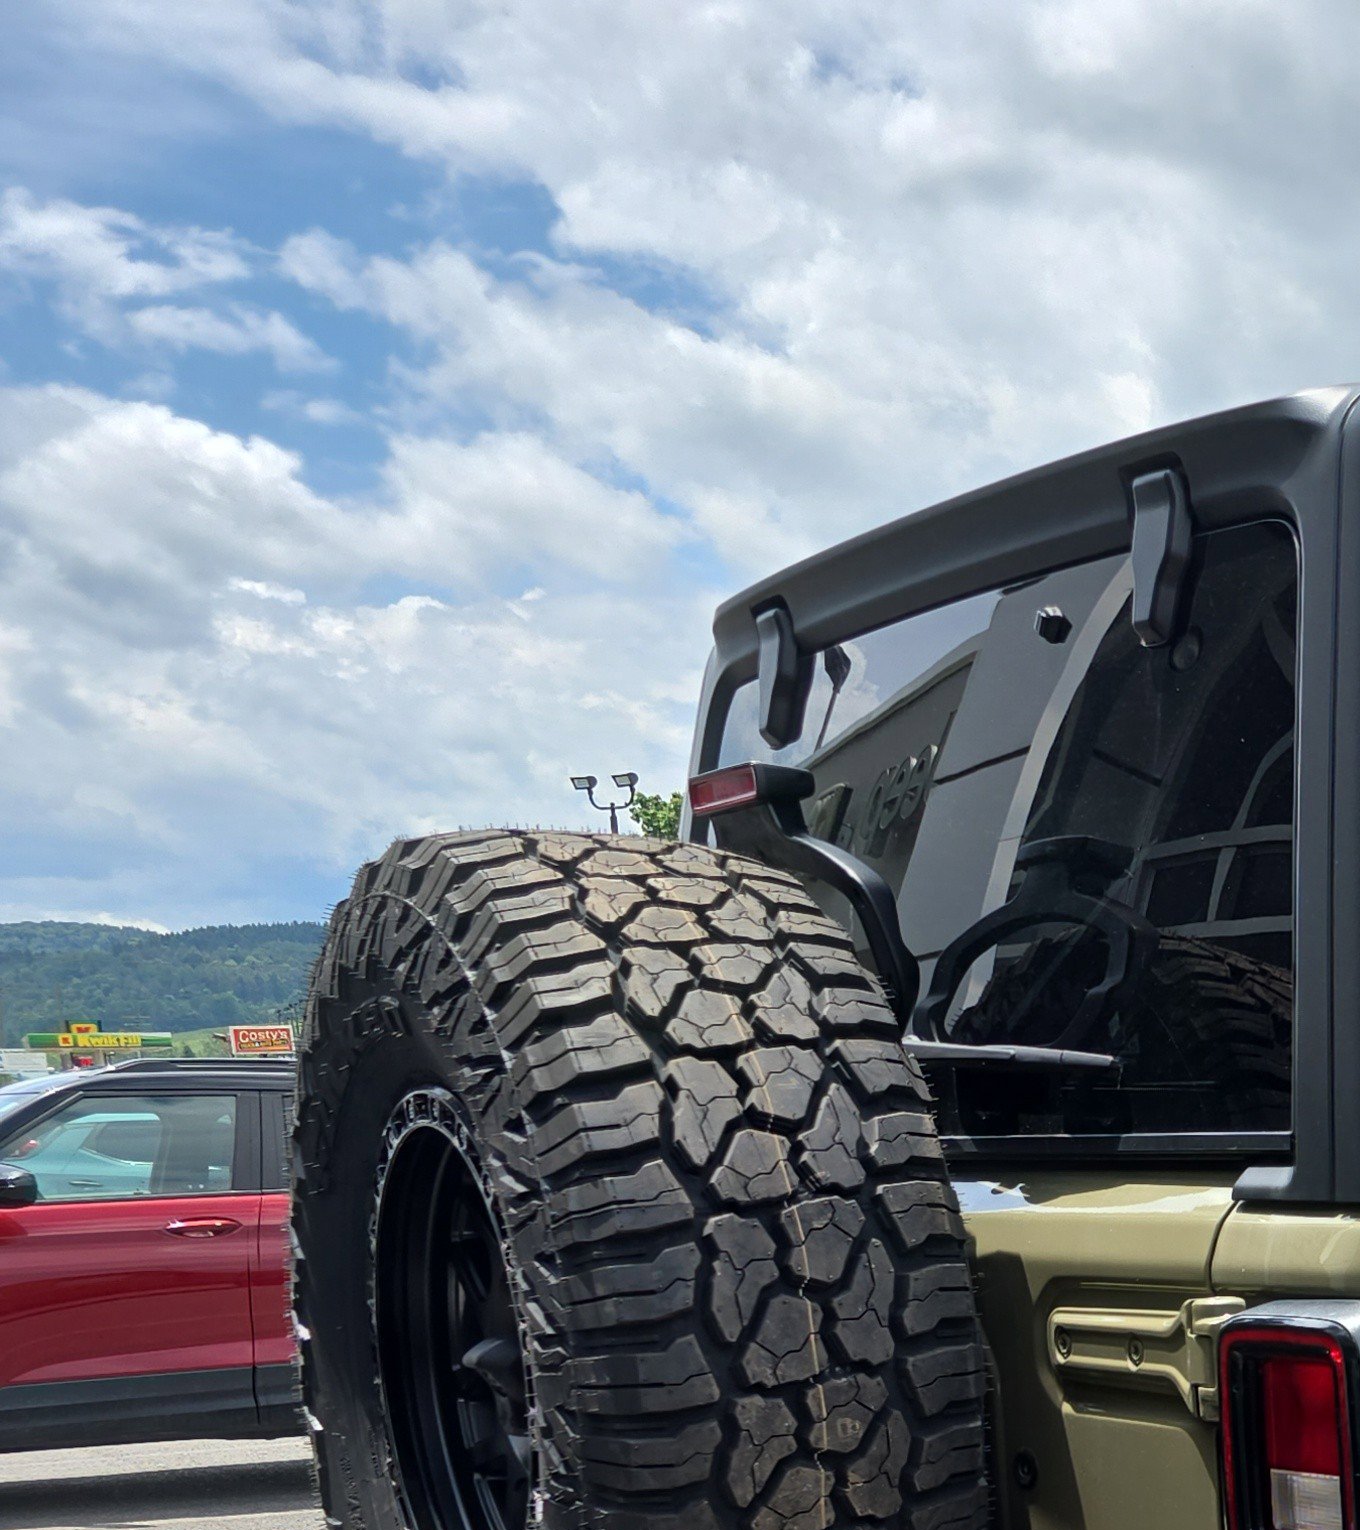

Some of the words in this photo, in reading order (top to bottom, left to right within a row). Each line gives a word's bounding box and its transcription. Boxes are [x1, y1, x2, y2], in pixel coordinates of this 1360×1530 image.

[77, 1034, 119, 1048] Kwik
[119, 1034, 141, 1047] Fill
[239, 1030, 288, 1043] Costy's
